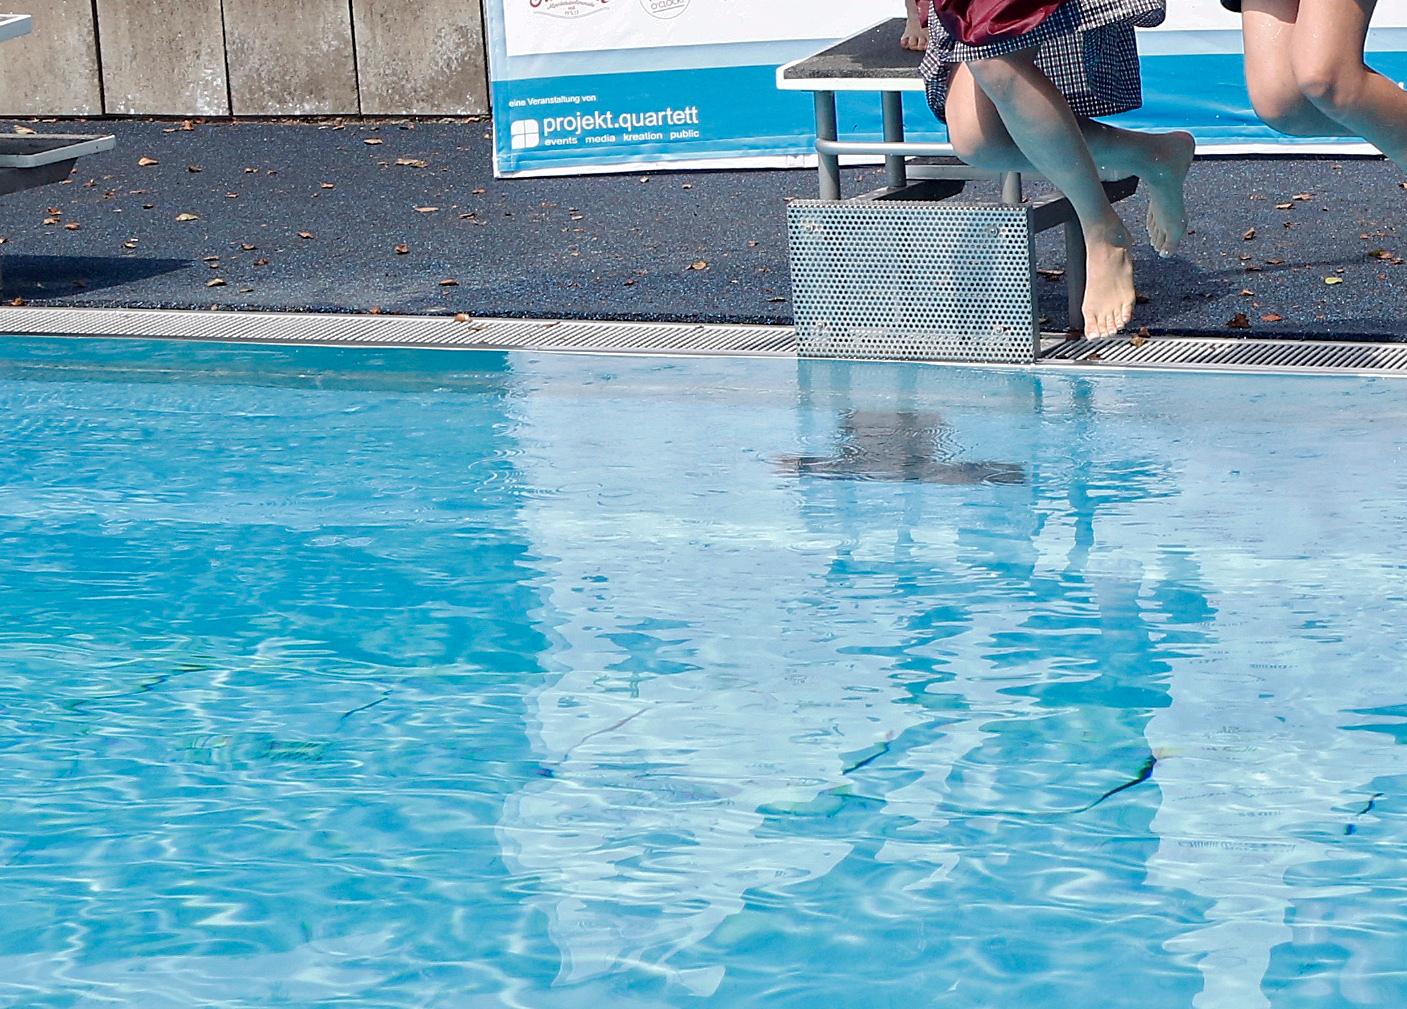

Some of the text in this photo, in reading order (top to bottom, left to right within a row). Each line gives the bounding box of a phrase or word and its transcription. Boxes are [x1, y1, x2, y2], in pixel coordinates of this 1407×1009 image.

[508, 94, 597, 107] eine Veranstaltung von
[543, 105, 699, 136] projekt.quartett
[544, 129, 699, 146] events media kreation public
